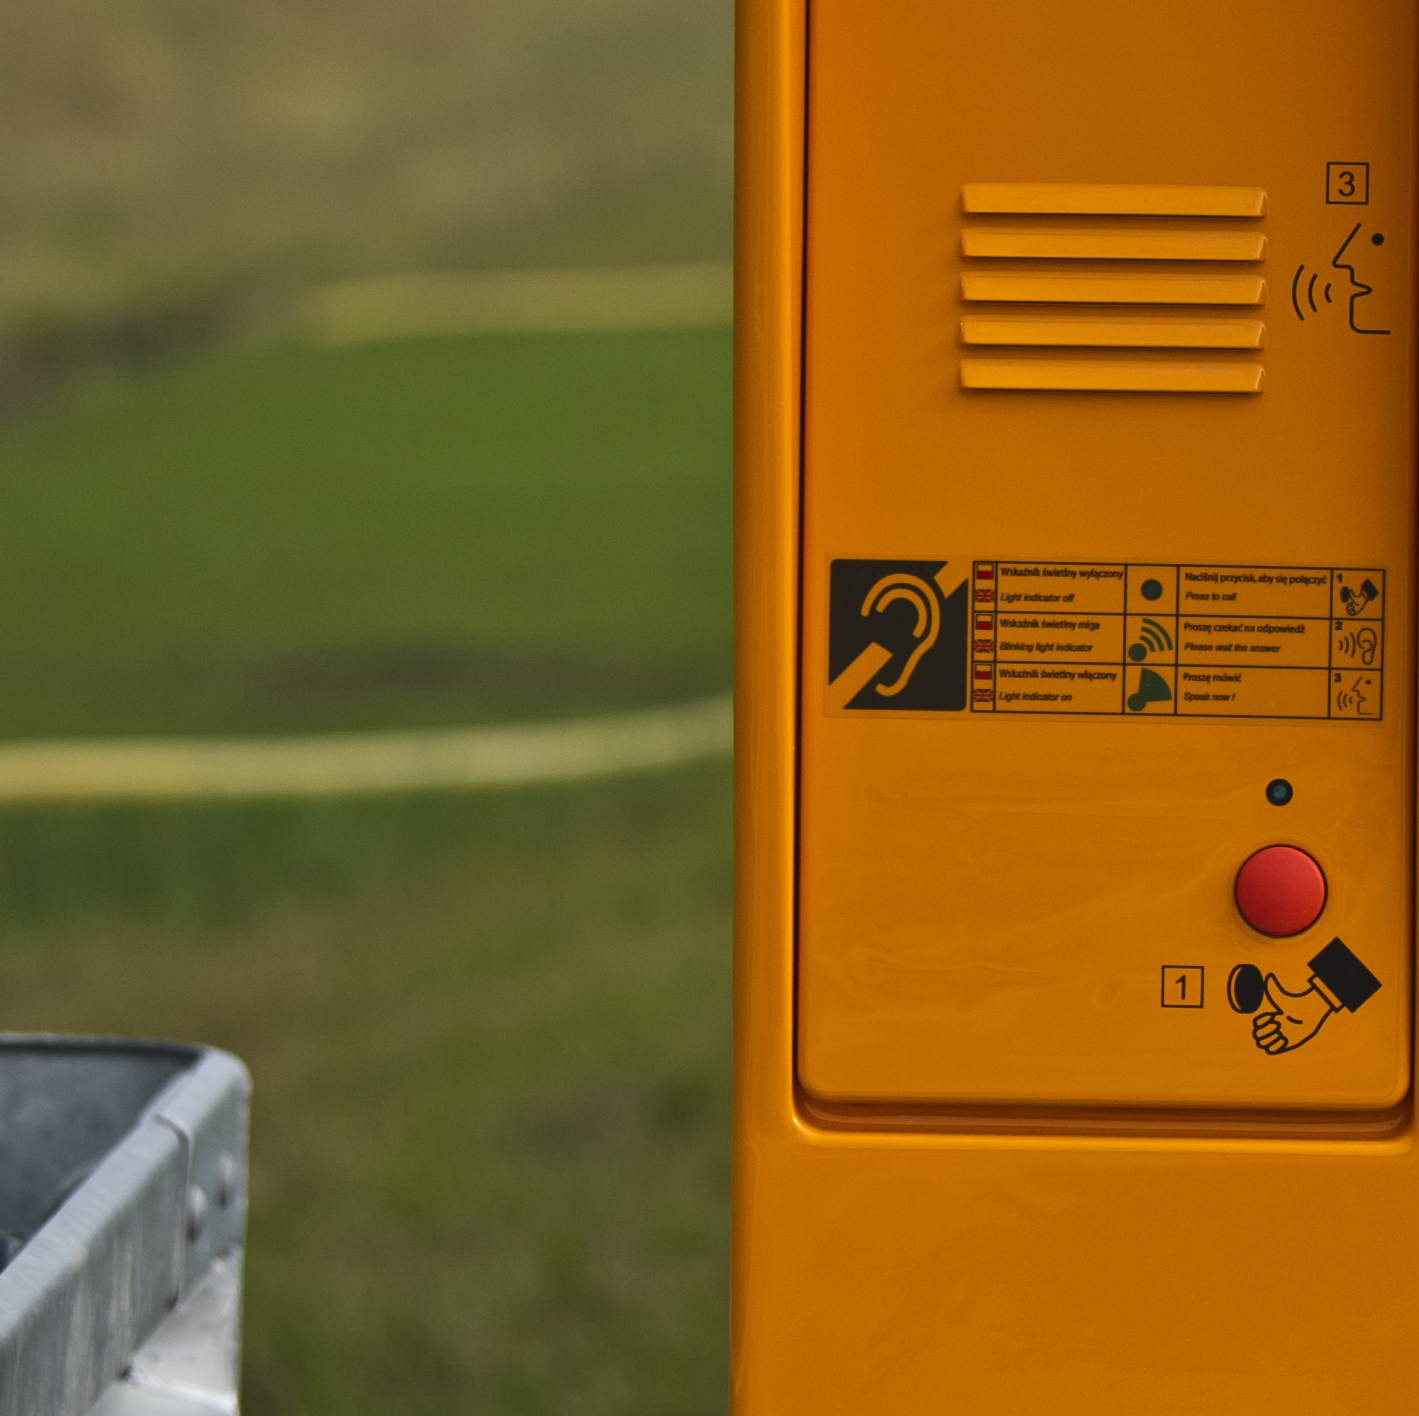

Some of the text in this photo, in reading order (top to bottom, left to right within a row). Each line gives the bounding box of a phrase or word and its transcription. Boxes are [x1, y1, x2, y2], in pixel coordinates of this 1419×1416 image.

[1338, 170, 1356, 197] 3
[1258, 573, 1274, 585] aby
[1336, 572, 1343, 583] 1
[1000, 592, 1075, 603] Light indicator off
[1185, 591, 1237, 601] Press to call
[1078, 619, 1100, 631] miga
[1244, 624, 1255, 633] na
[1335, 620, 1343, 631] 2
[1000, 641, 1094, 653] Blinking light indicator
[1184, 642, 1214, 652] Please
[1215, 642, 1232, 652] wait
[1234, 643, 1248, 652] the
[1334, 673, 1342, 683] 3
[998, 691, 1073, 702] Light indicator on
[1184, 691, 1210, 702] Speak
[1212, 692, 1230, 702] now
[1175, 974, 1186, 1001] 1
